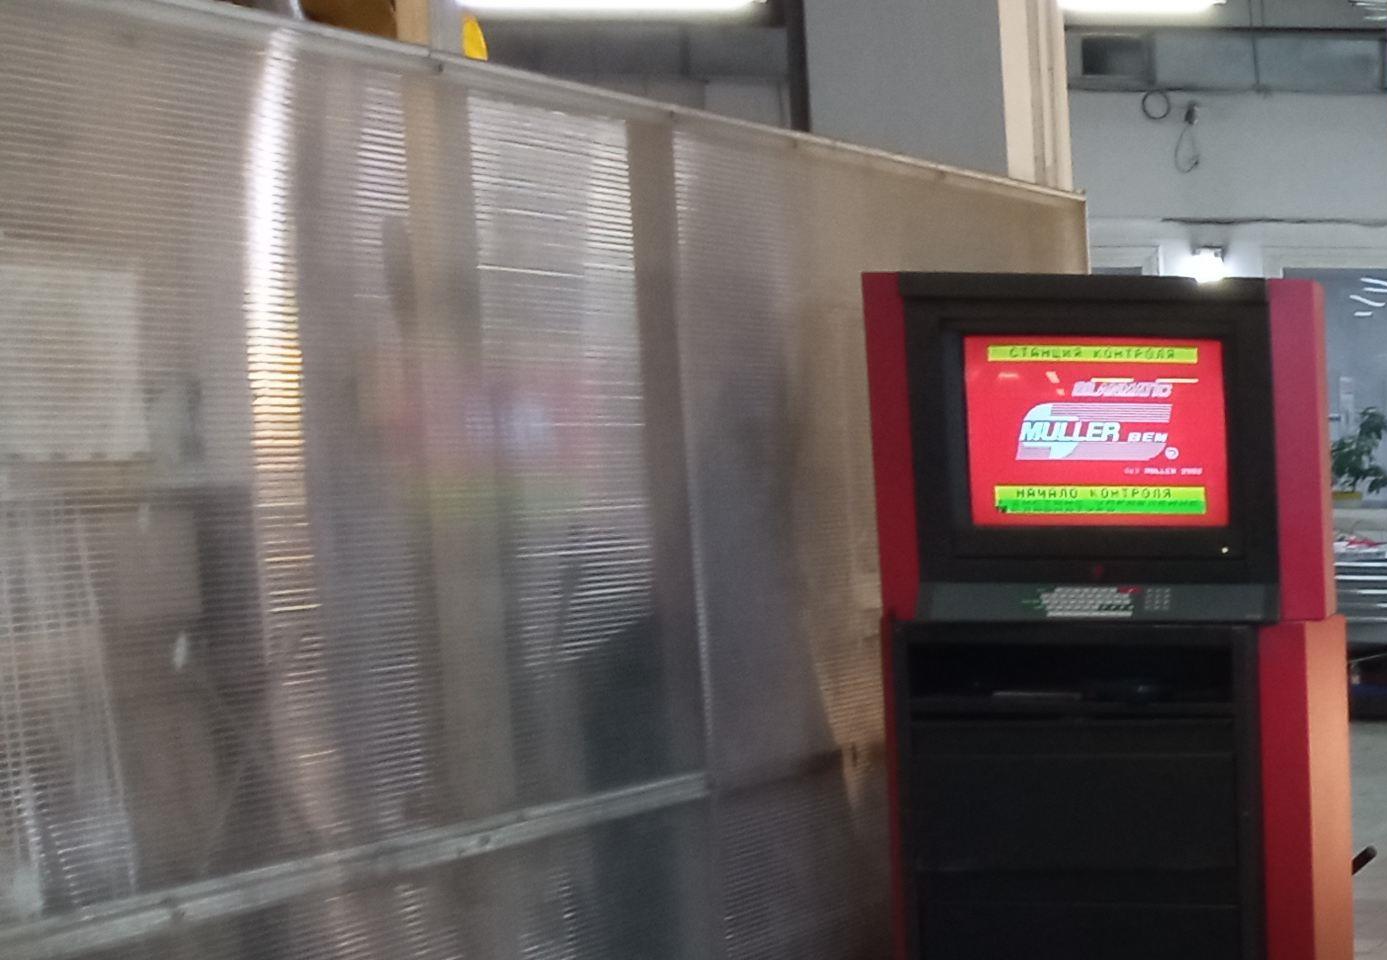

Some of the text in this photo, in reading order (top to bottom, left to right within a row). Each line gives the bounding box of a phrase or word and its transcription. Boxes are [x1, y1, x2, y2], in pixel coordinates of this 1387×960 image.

[1092, 347, 1175, 360] КОНТРОЛЯ
[1020, 421, 1120, 442] MULLER
[1016, 488, 1172, 500] НАЧАЛО КОНТРОЛЯ
